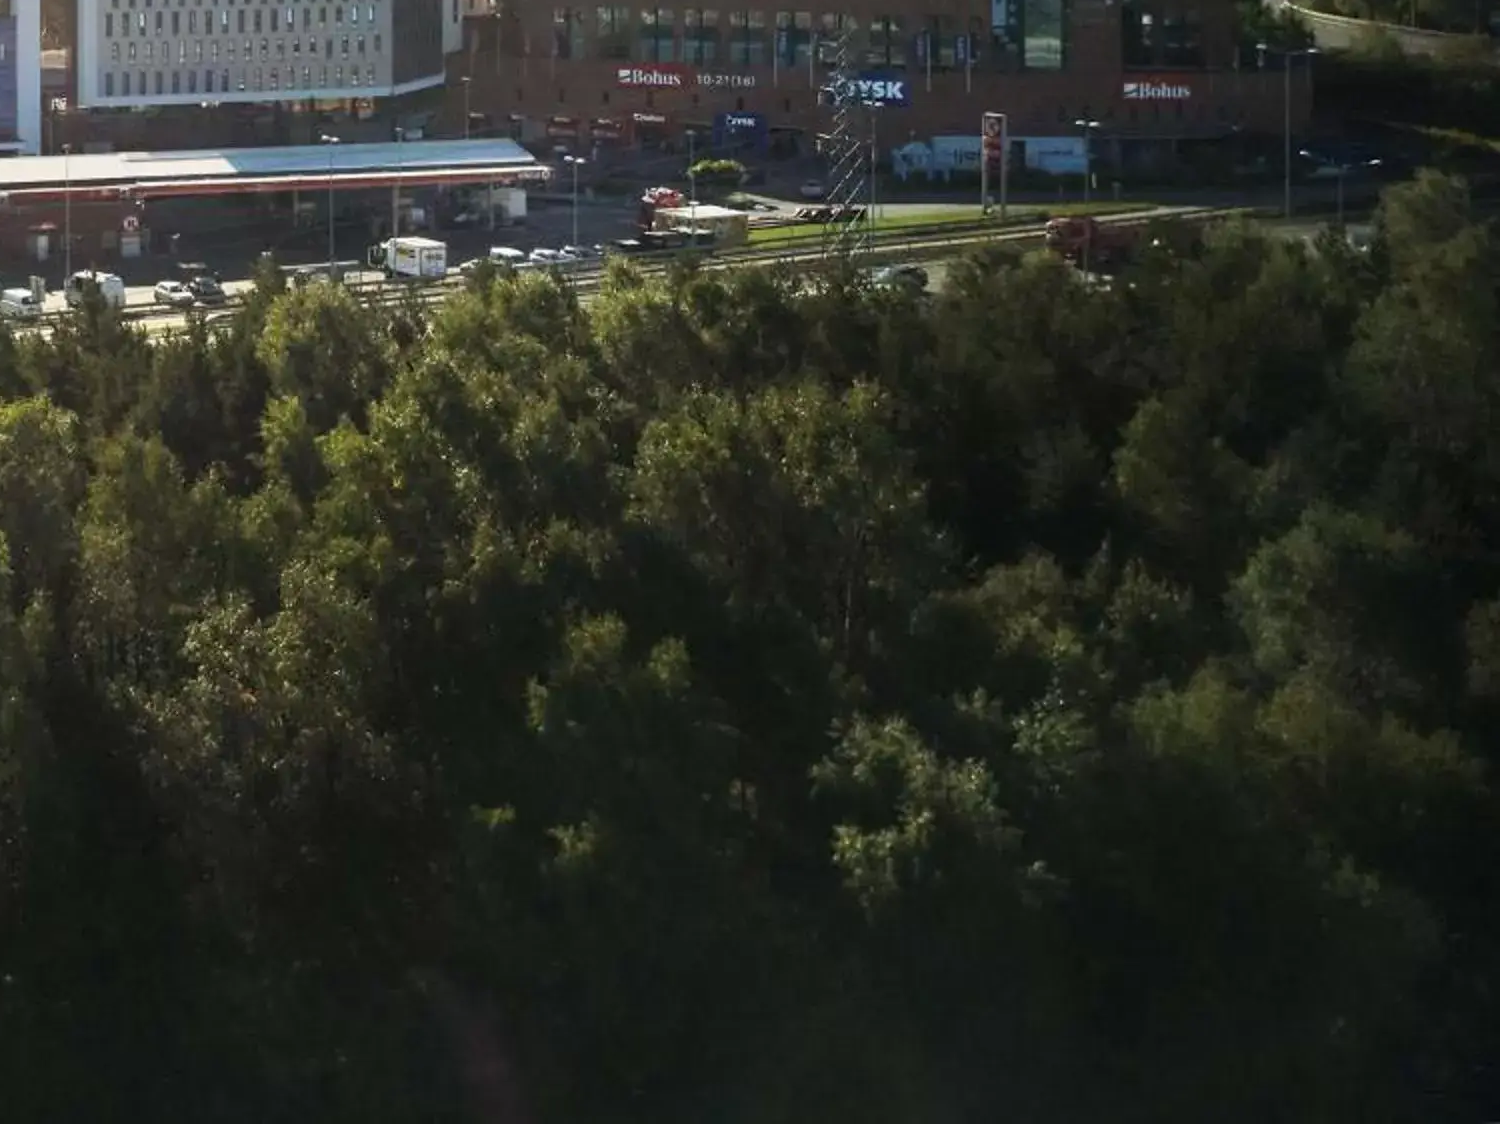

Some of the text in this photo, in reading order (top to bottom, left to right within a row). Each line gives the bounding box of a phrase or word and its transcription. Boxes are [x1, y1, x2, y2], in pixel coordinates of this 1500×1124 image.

[632, 68, 681, 85] Bohus
[846, 79, 904, 100] JYSK
[1139, 81, 1191, 99] Bohus
